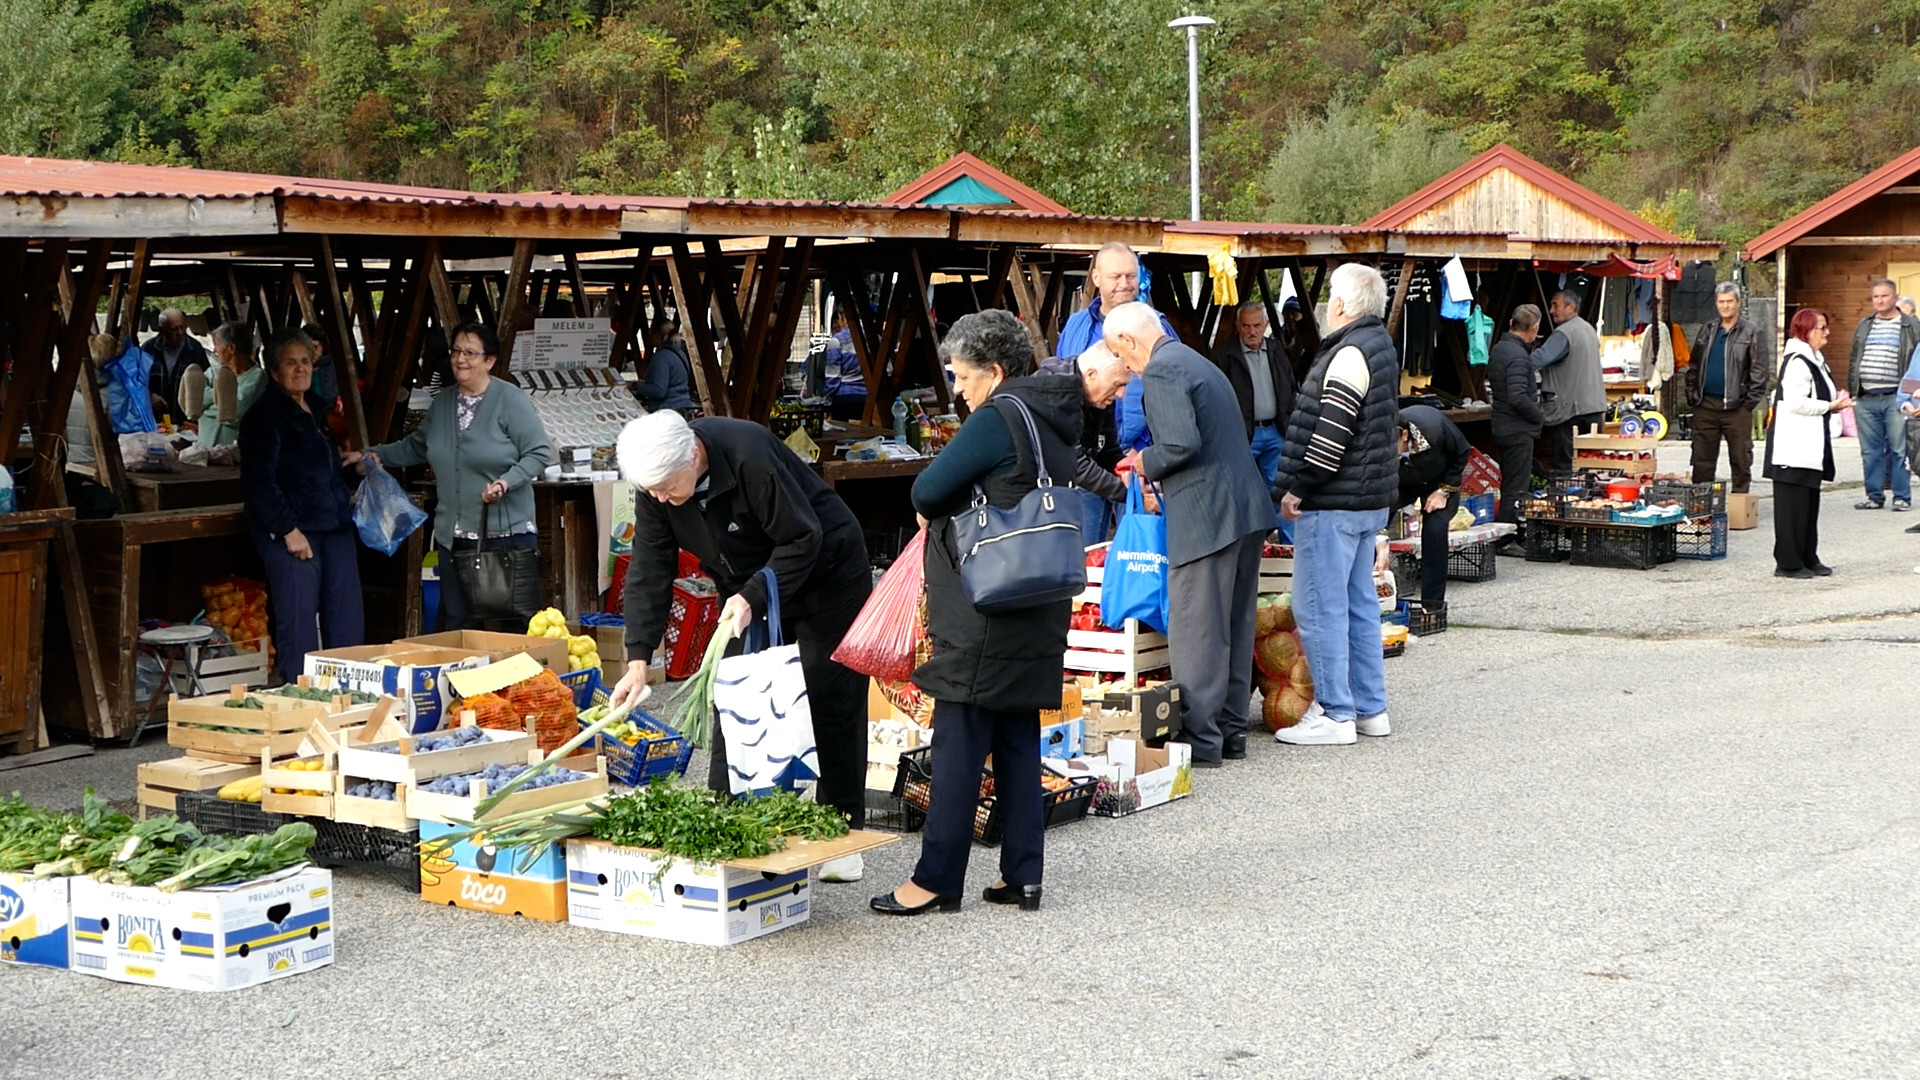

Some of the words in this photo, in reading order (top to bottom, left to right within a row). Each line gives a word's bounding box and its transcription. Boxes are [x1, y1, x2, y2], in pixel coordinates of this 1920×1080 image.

[552, 321, 585, 330] MELEM
[608, 847, 649, 858] PREMIUM
[248, 890, 284, 902] PREMIUM
[287, 883, 305, 894] PACK
[461, 873, 507, 905] toco
[614, 868, 665, 902] BONITA
[760, 902, 782, 923] BONITA
[117, 913, 165, 950] BONITA
[267, 946, 296, 970] BONITA
